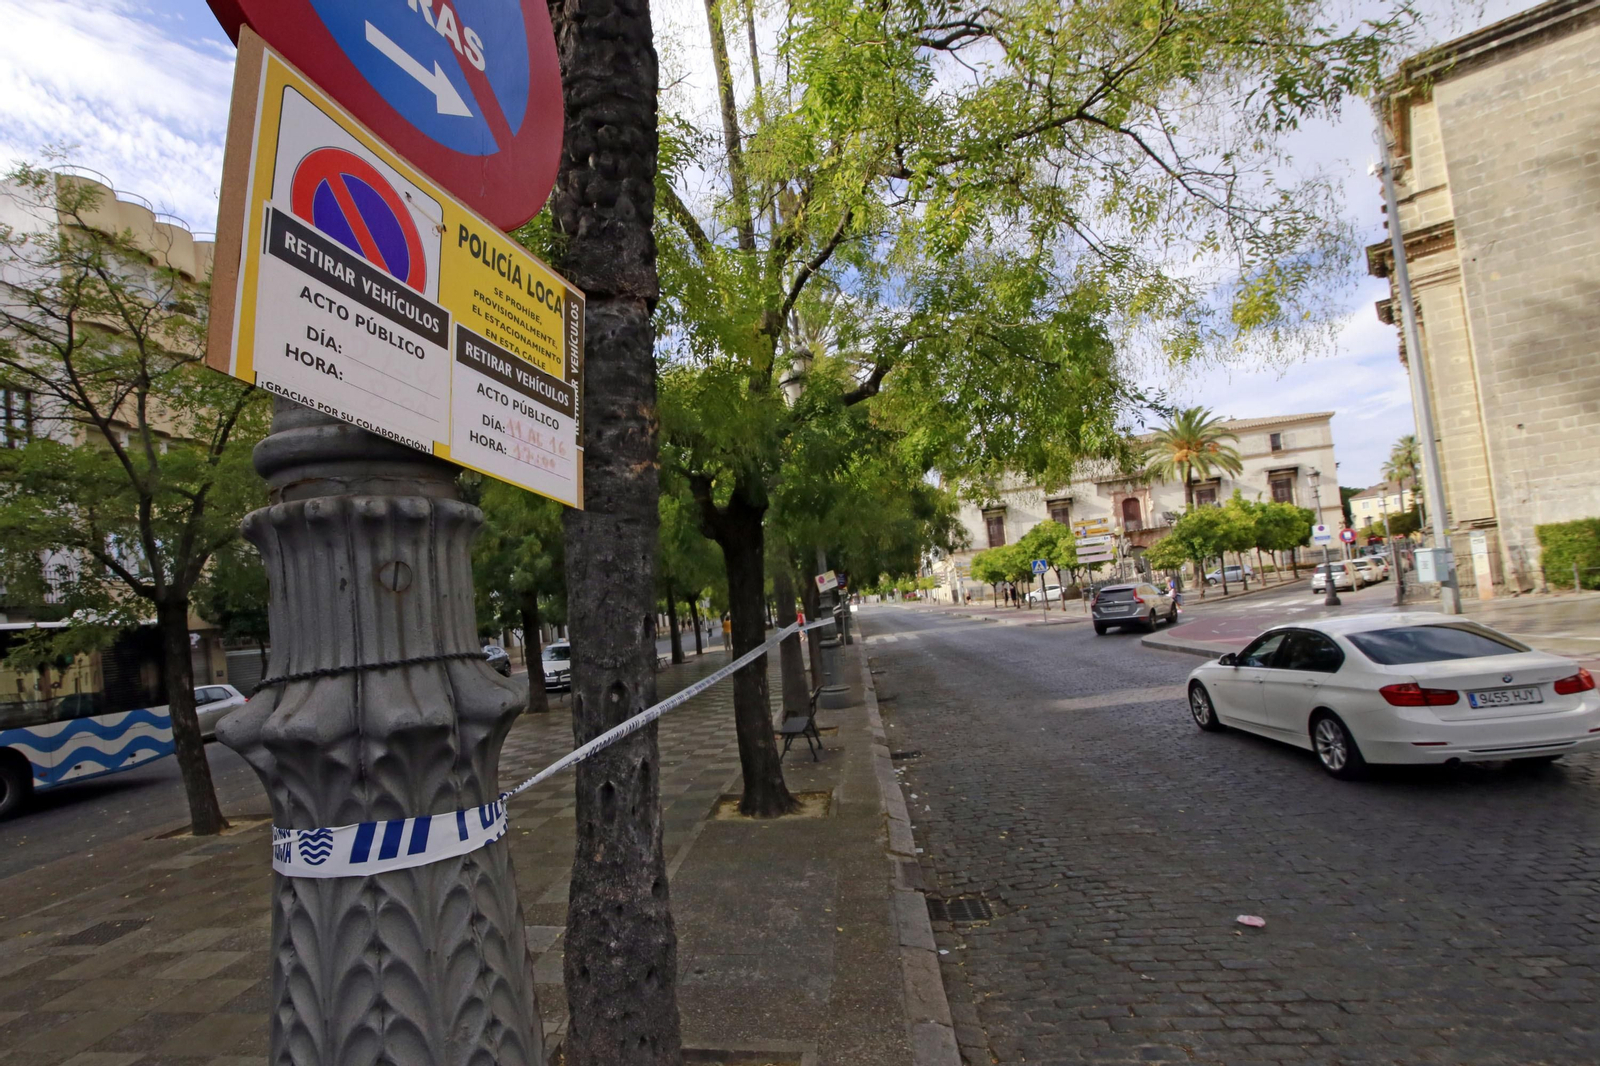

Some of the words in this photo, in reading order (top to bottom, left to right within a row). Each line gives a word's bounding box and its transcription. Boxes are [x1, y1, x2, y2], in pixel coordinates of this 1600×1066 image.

[458, 223, 523, 291] POLICÍA
[284, 231, 356, 287] RETIRAR
[361, 275, 440, 333] VEHÍCULOS
[299, 286, 349, 321] ACTO
[355, 313, 425, 360] PÚBLICO
[473, 289, 558, 350] PROVISIONALMENTE,
[493, 286, 504, 299] SE
[505, 294, 542, 326] PROHÍBE,
[306, 325, 342, 354] DÍA:
[472, 303, 483, 317] EL
[484, 311, 562, 365] ESTACIONAMIENTO
[485, 328, 498, 342] EN
[499, 335, 521, 356] ESTA
[522, 351, 546, 371] CALLE
[568, 301, 579, 374] VEHÍCULOS
[285, 343, 344, 381] HORA:
[465, 341, 513, 379] RETIRAR
[515, 367, 570, 407] VEHÍCULOS
[260, 381, 315, 407] ¡GRACIAS
[317, 401, 339, 418] POR
[340, 411, 354, 423] SU
[476, 382, 509, 407] ACTO
[512, 400, 560, 430] PÚBLICO
[482, 413, 506, 434] DÍA:
[469, 430, 507, 455] HORA:
[1479, 691, 1510, 705] 9455
